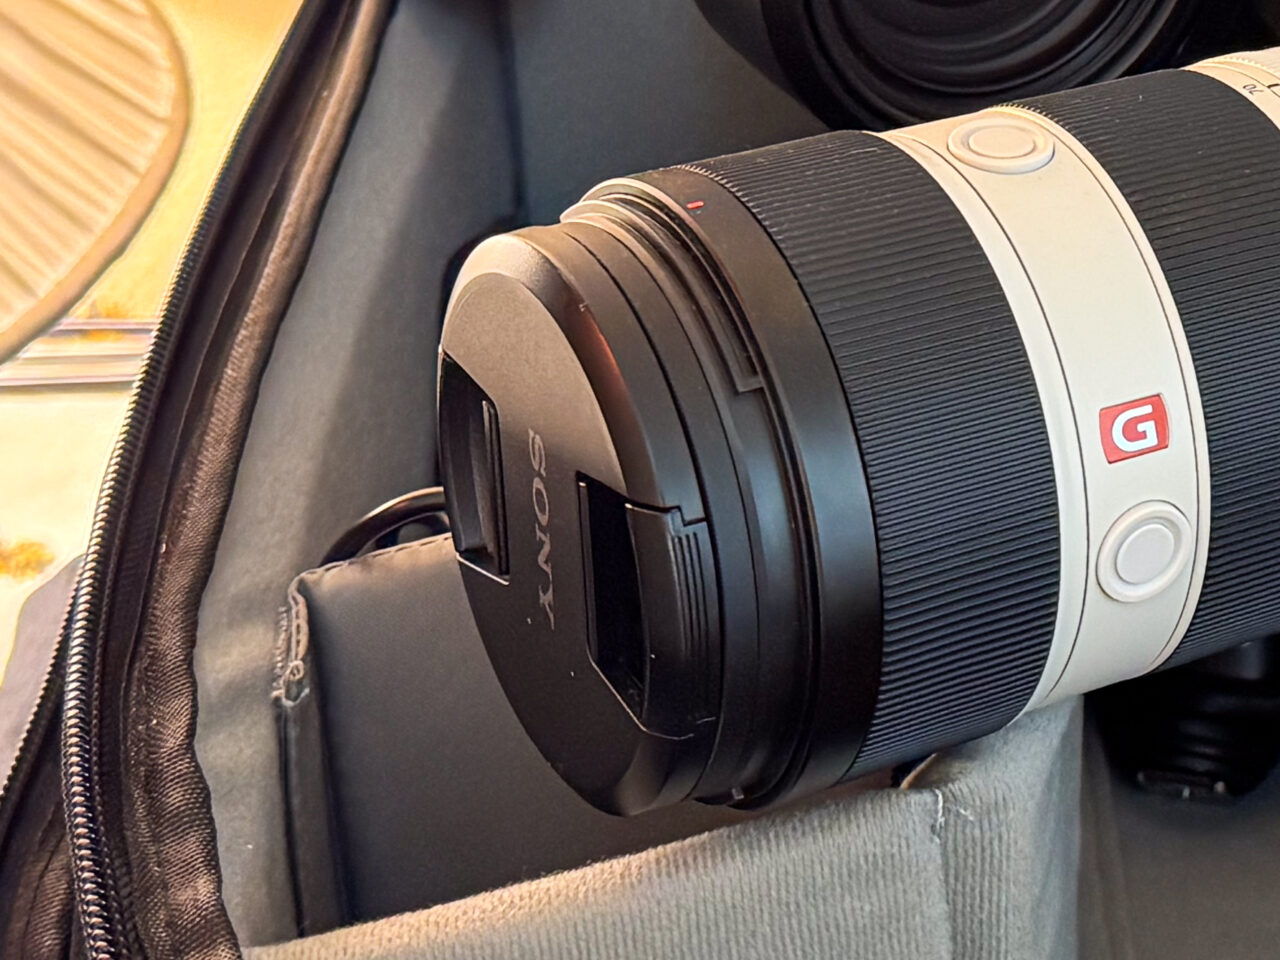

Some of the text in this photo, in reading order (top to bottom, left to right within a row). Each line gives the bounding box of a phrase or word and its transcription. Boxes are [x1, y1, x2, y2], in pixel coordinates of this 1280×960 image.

[1243, 82, 1265, 96] 70
[1111, 404, 1160, 454] G
[528, 428, 555, 630] SONY
